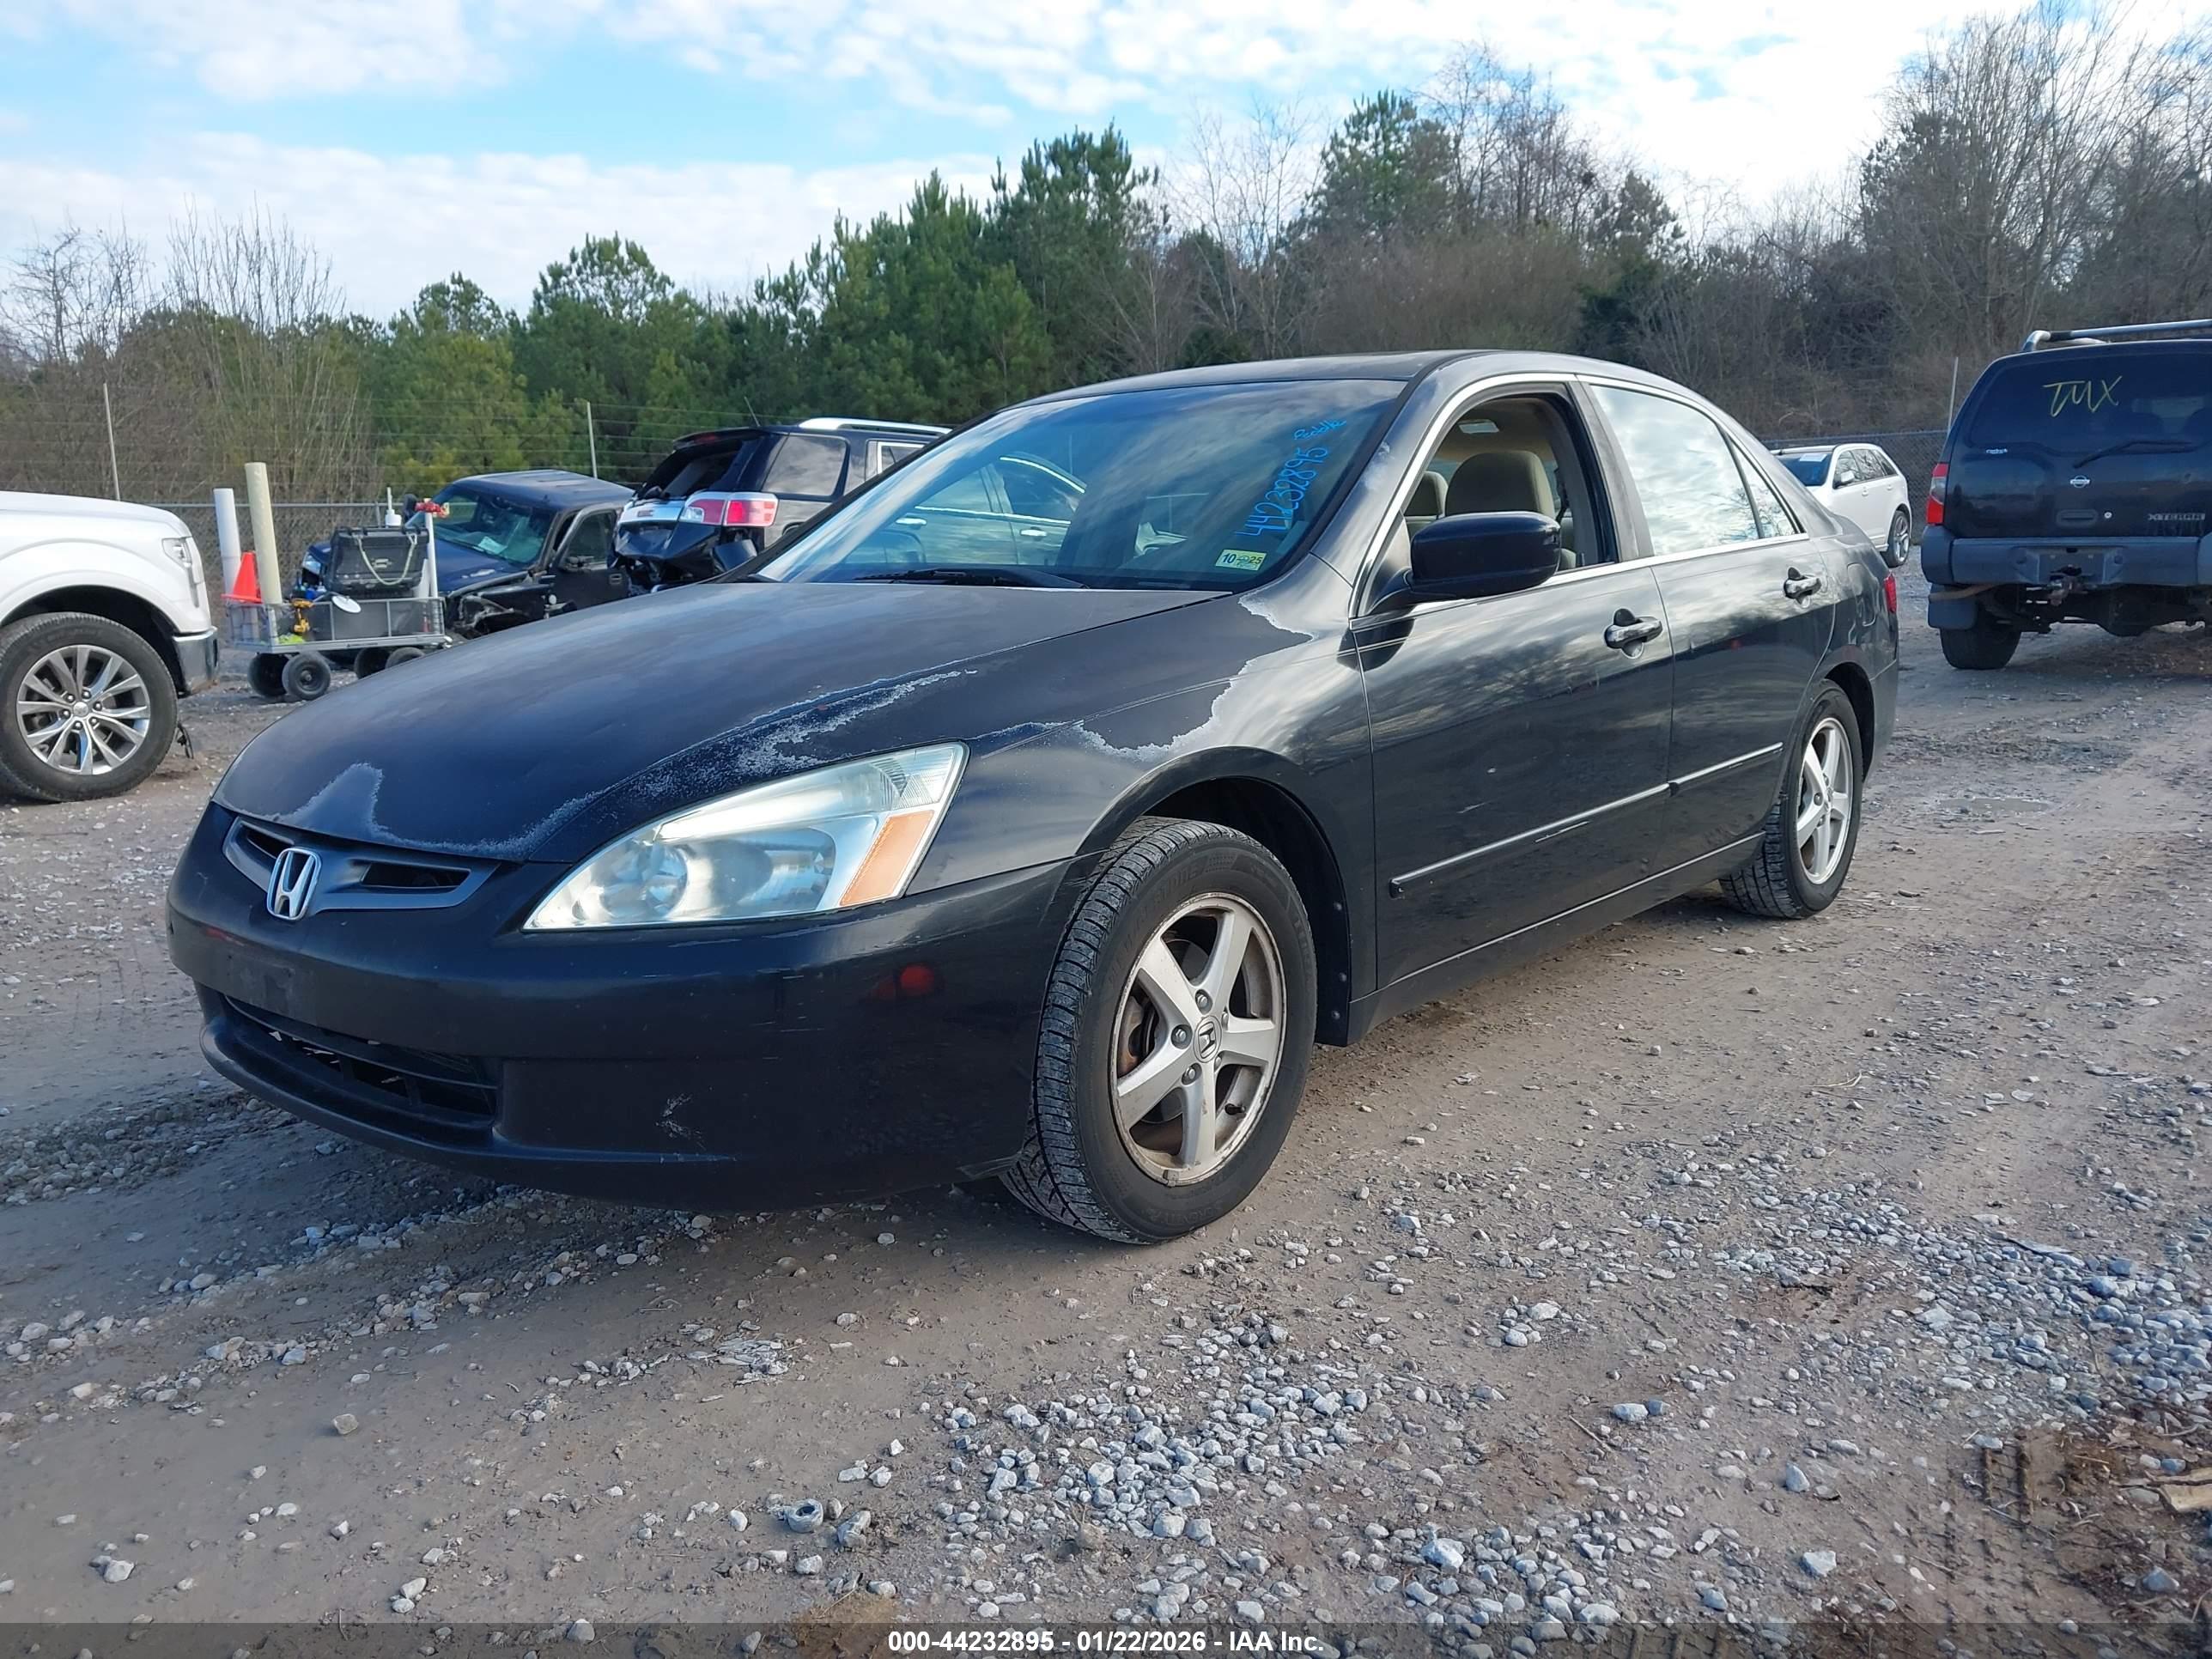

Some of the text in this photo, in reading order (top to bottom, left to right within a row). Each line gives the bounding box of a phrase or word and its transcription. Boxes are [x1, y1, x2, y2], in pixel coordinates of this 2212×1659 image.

[1235, 447, 1328, 536] 44232895
[1222, 552, 1263, 565] 10 25
